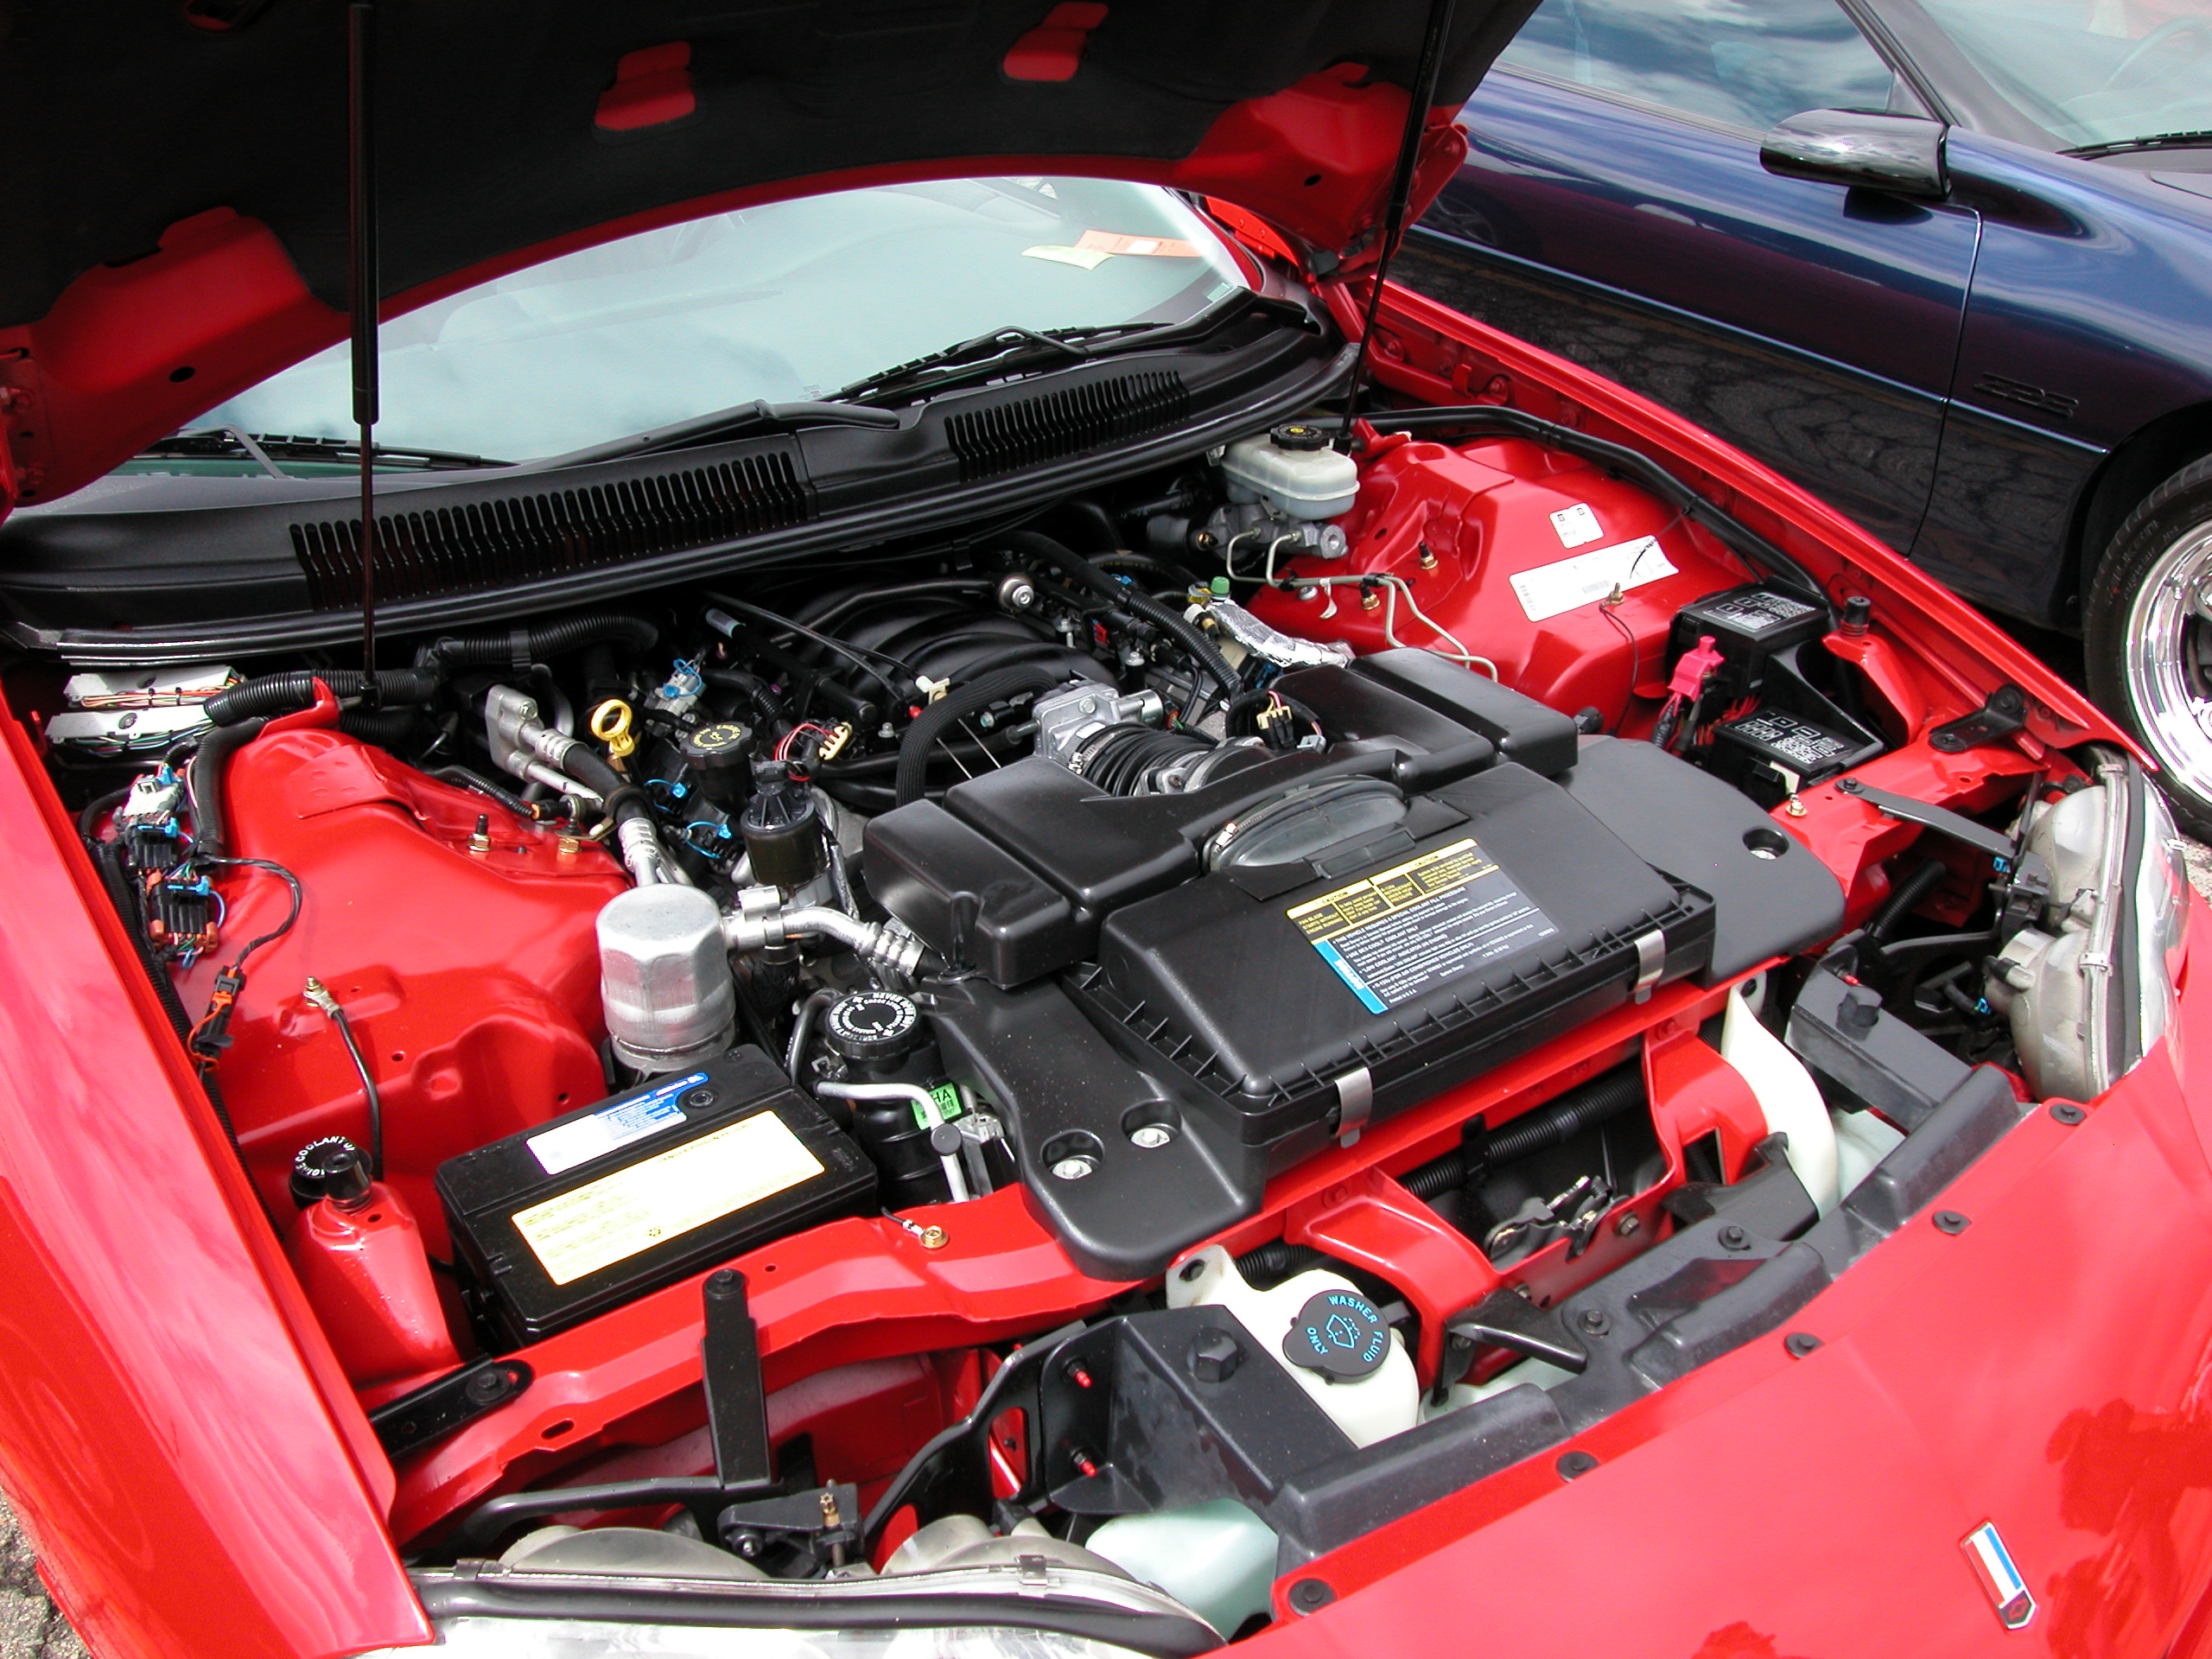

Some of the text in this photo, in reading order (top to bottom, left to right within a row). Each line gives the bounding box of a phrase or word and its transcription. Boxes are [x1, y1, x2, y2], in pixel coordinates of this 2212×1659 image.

[1321, 891, 1348, 904] CAUTION
[873, 993, 903, 1003] NEVER
[1327, 1295, 1383, 1362] WASHER FLUID
[1306, 1327, 1329, 1355] ONLY
